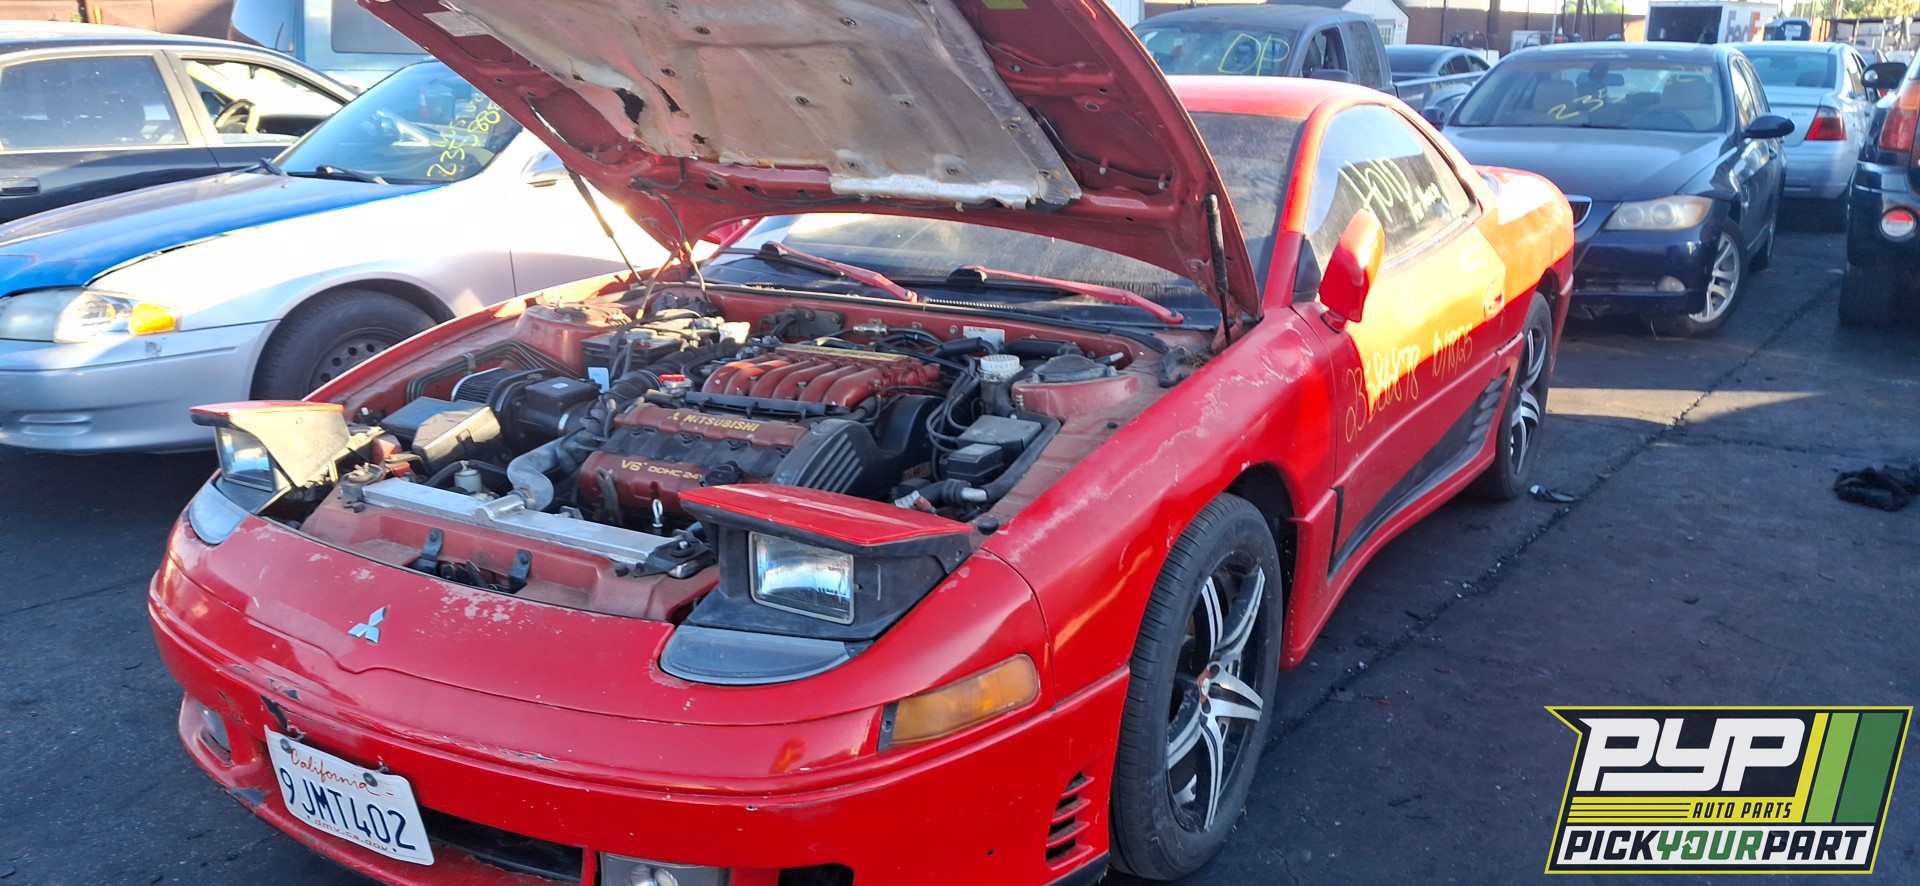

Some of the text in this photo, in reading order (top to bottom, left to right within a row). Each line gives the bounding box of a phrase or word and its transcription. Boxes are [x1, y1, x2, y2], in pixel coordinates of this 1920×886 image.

[1725, 10, 1761, 43] FedE
[683, 413, 761, 432] MITSUBISHI
[648, 465, 683, 478] DOHC
[289, 747, 380, 797] California
[279, 767, 416, 851] 9JMT402
[313, 818, 390, 853] dmv.ca.gov
